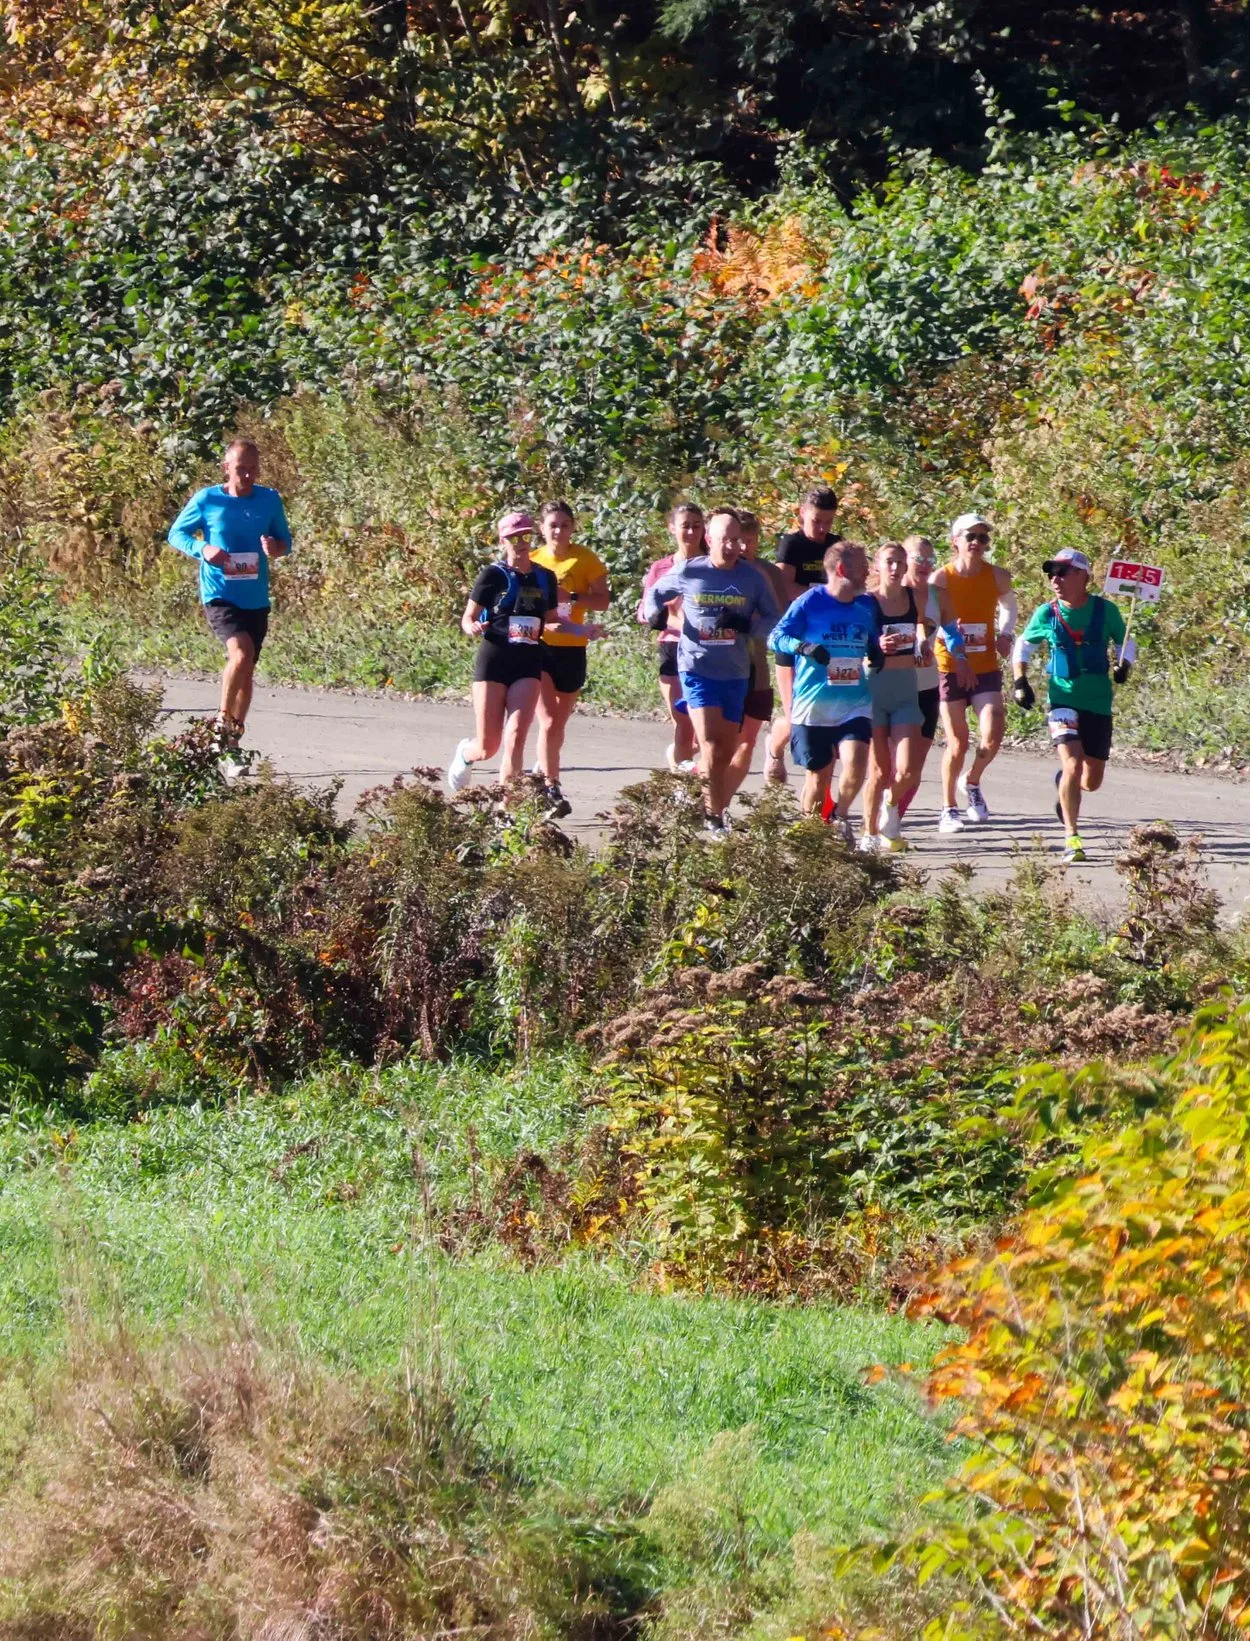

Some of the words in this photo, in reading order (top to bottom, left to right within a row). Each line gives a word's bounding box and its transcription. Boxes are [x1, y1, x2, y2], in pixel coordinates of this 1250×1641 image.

[1115, 566, 1156, 584] 1:45
[693, 594, 747, 605] VERMONT
[822, 633, 848, 641] WEST
[835, 667, 853, 678] 127
